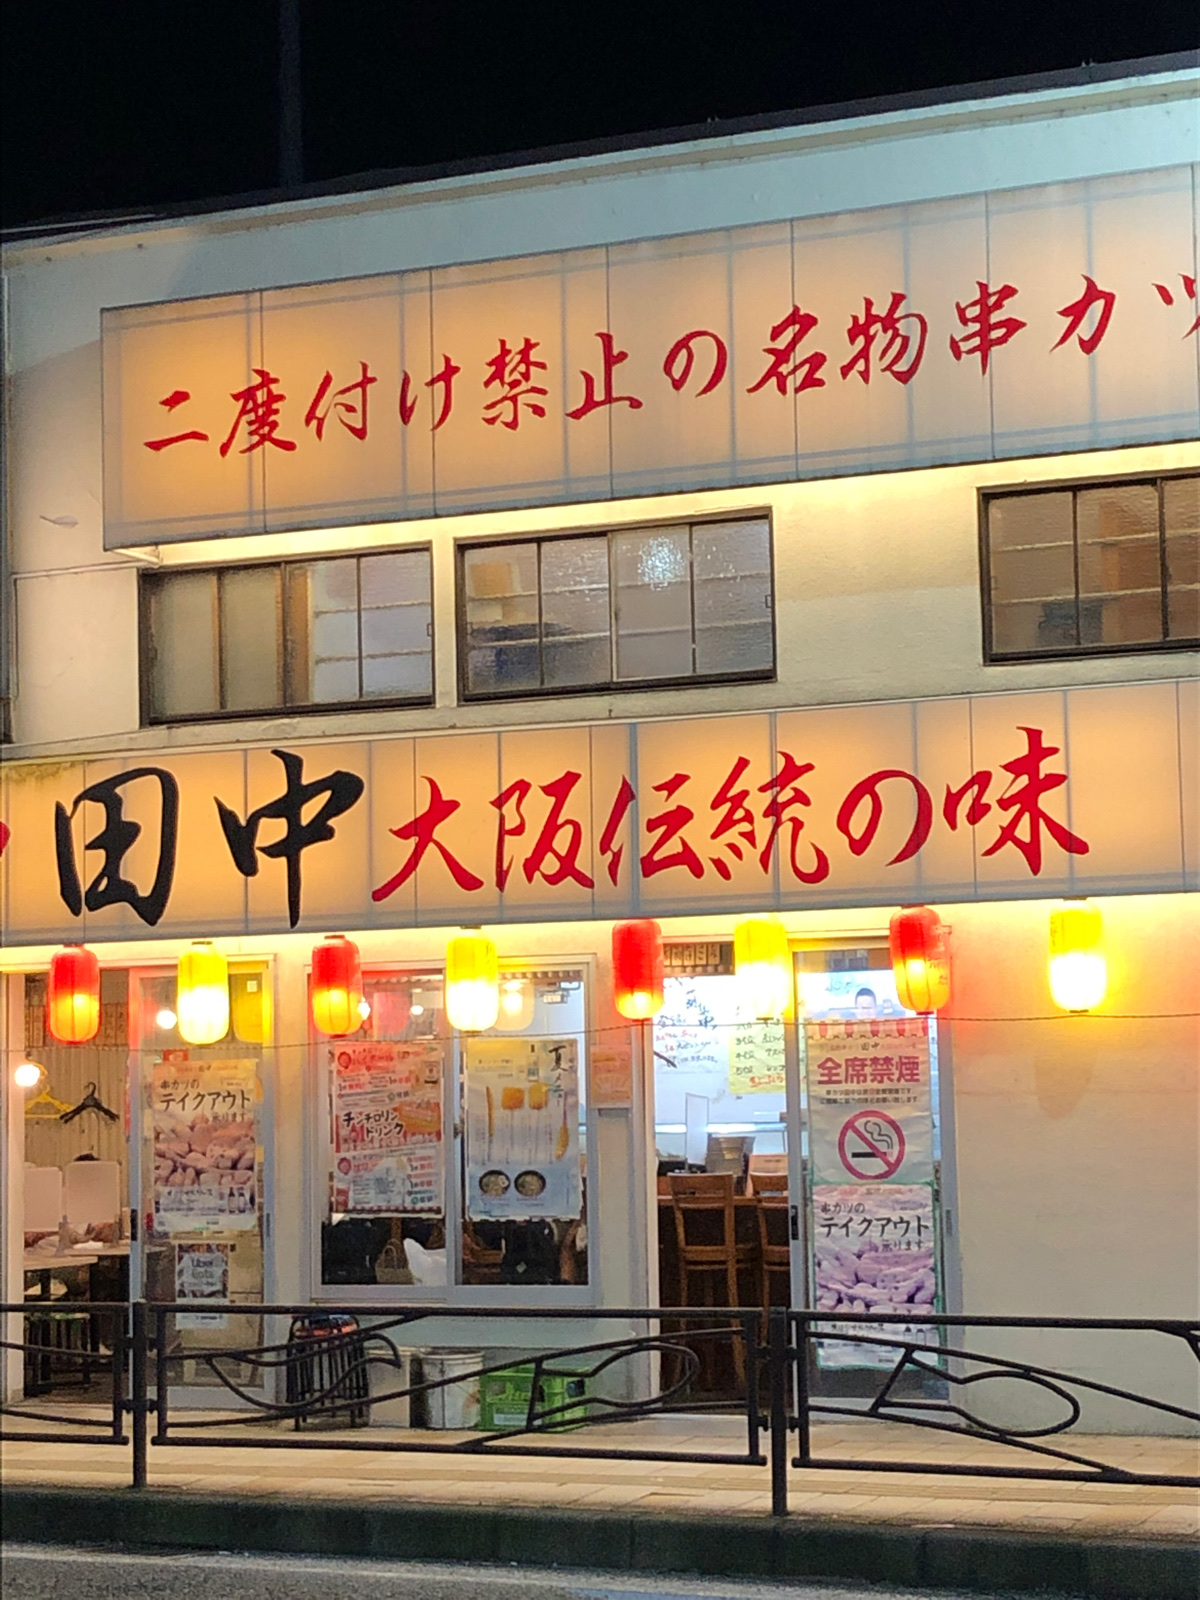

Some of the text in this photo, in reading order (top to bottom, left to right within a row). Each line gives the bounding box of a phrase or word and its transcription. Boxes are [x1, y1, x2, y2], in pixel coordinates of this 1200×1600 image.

[54, 726, 1090, 928] 田中 大阪伝統の味
[817, 1055, 920, 1085] 全席禁煙
[160, 1089, 250, 1112] テイクアウト
[343, 1110, 398, 1127] チンチロリン
[366, 1122, 404, 1139] ドリンク
[820, 1215, 929, 1238] テイクアウト
